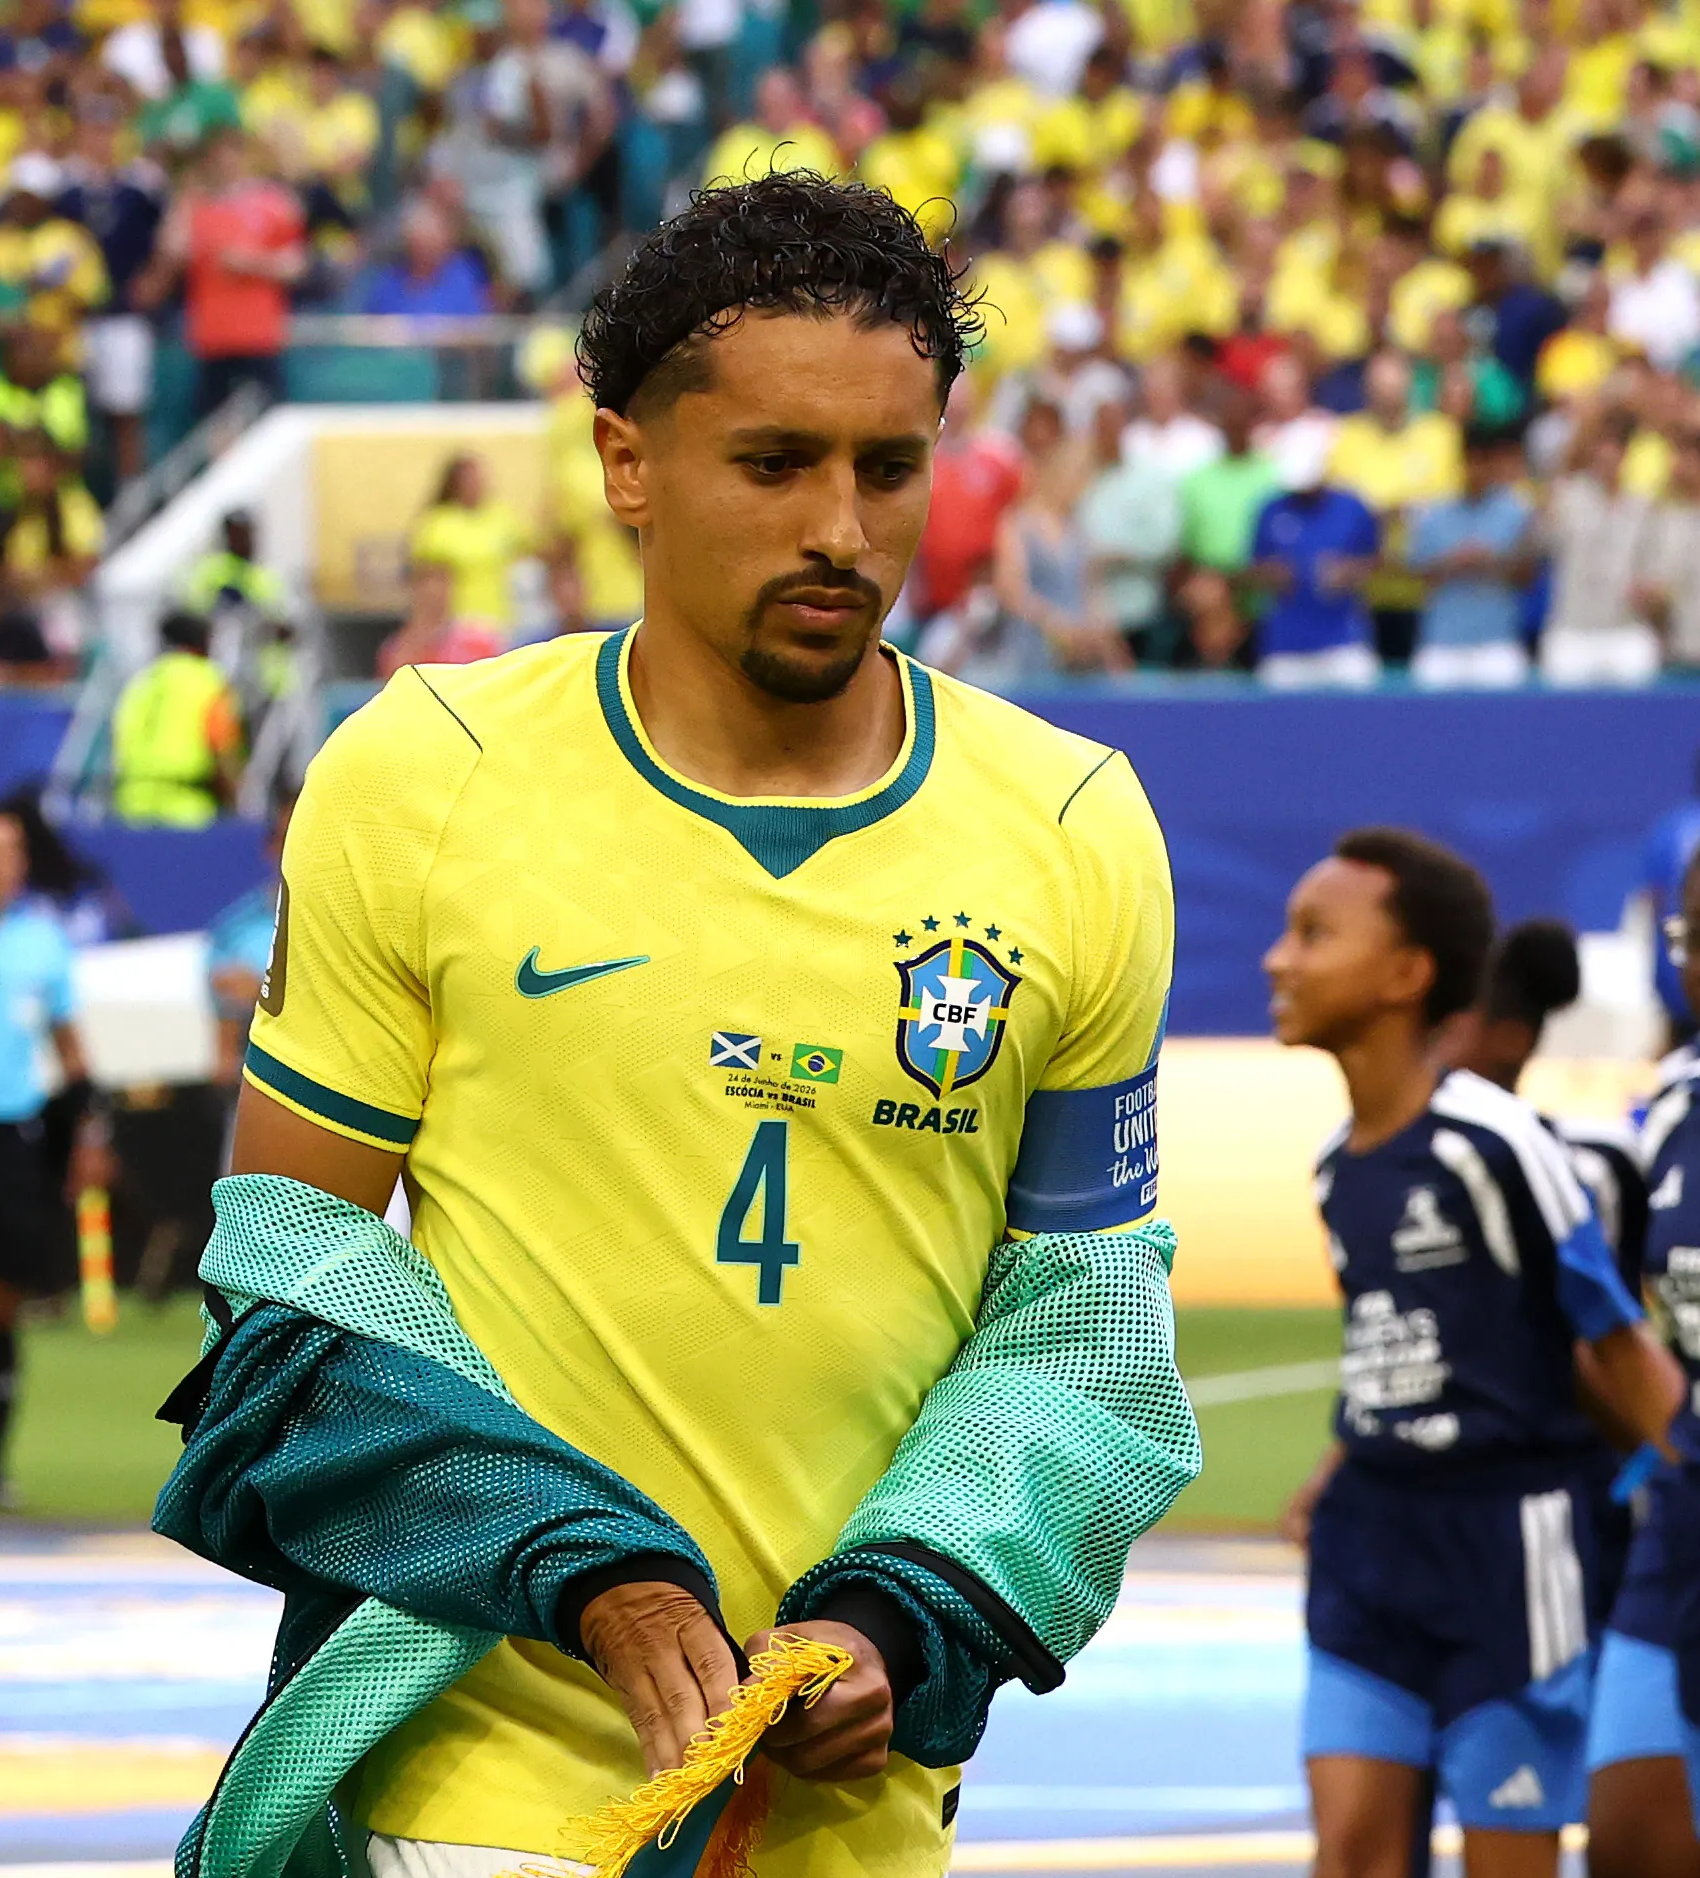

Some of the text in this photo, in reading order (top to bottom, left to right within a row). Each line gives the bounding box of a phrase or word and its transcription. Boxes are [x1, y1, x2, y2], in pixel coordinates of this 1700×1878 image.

[933, 1003, 977, 1024] CBF
[771, 1053, 782, 1061] vs
[725, 1084, 816, 1109] ESCÓCIA vs BRASIL
[728, 1073, 816, 1095] 24 de Junho de 2026
[744, 1101, 769, 1110] Miami
[775, 1103, 794, 1112] EUA
[872, 1099, 979, 1134] BRASIL
[1113, 1103, 1157, 1154] UNIT
[1106, 1155, 1144, 1188] the
[715, 1119, 801, 1306] 4
